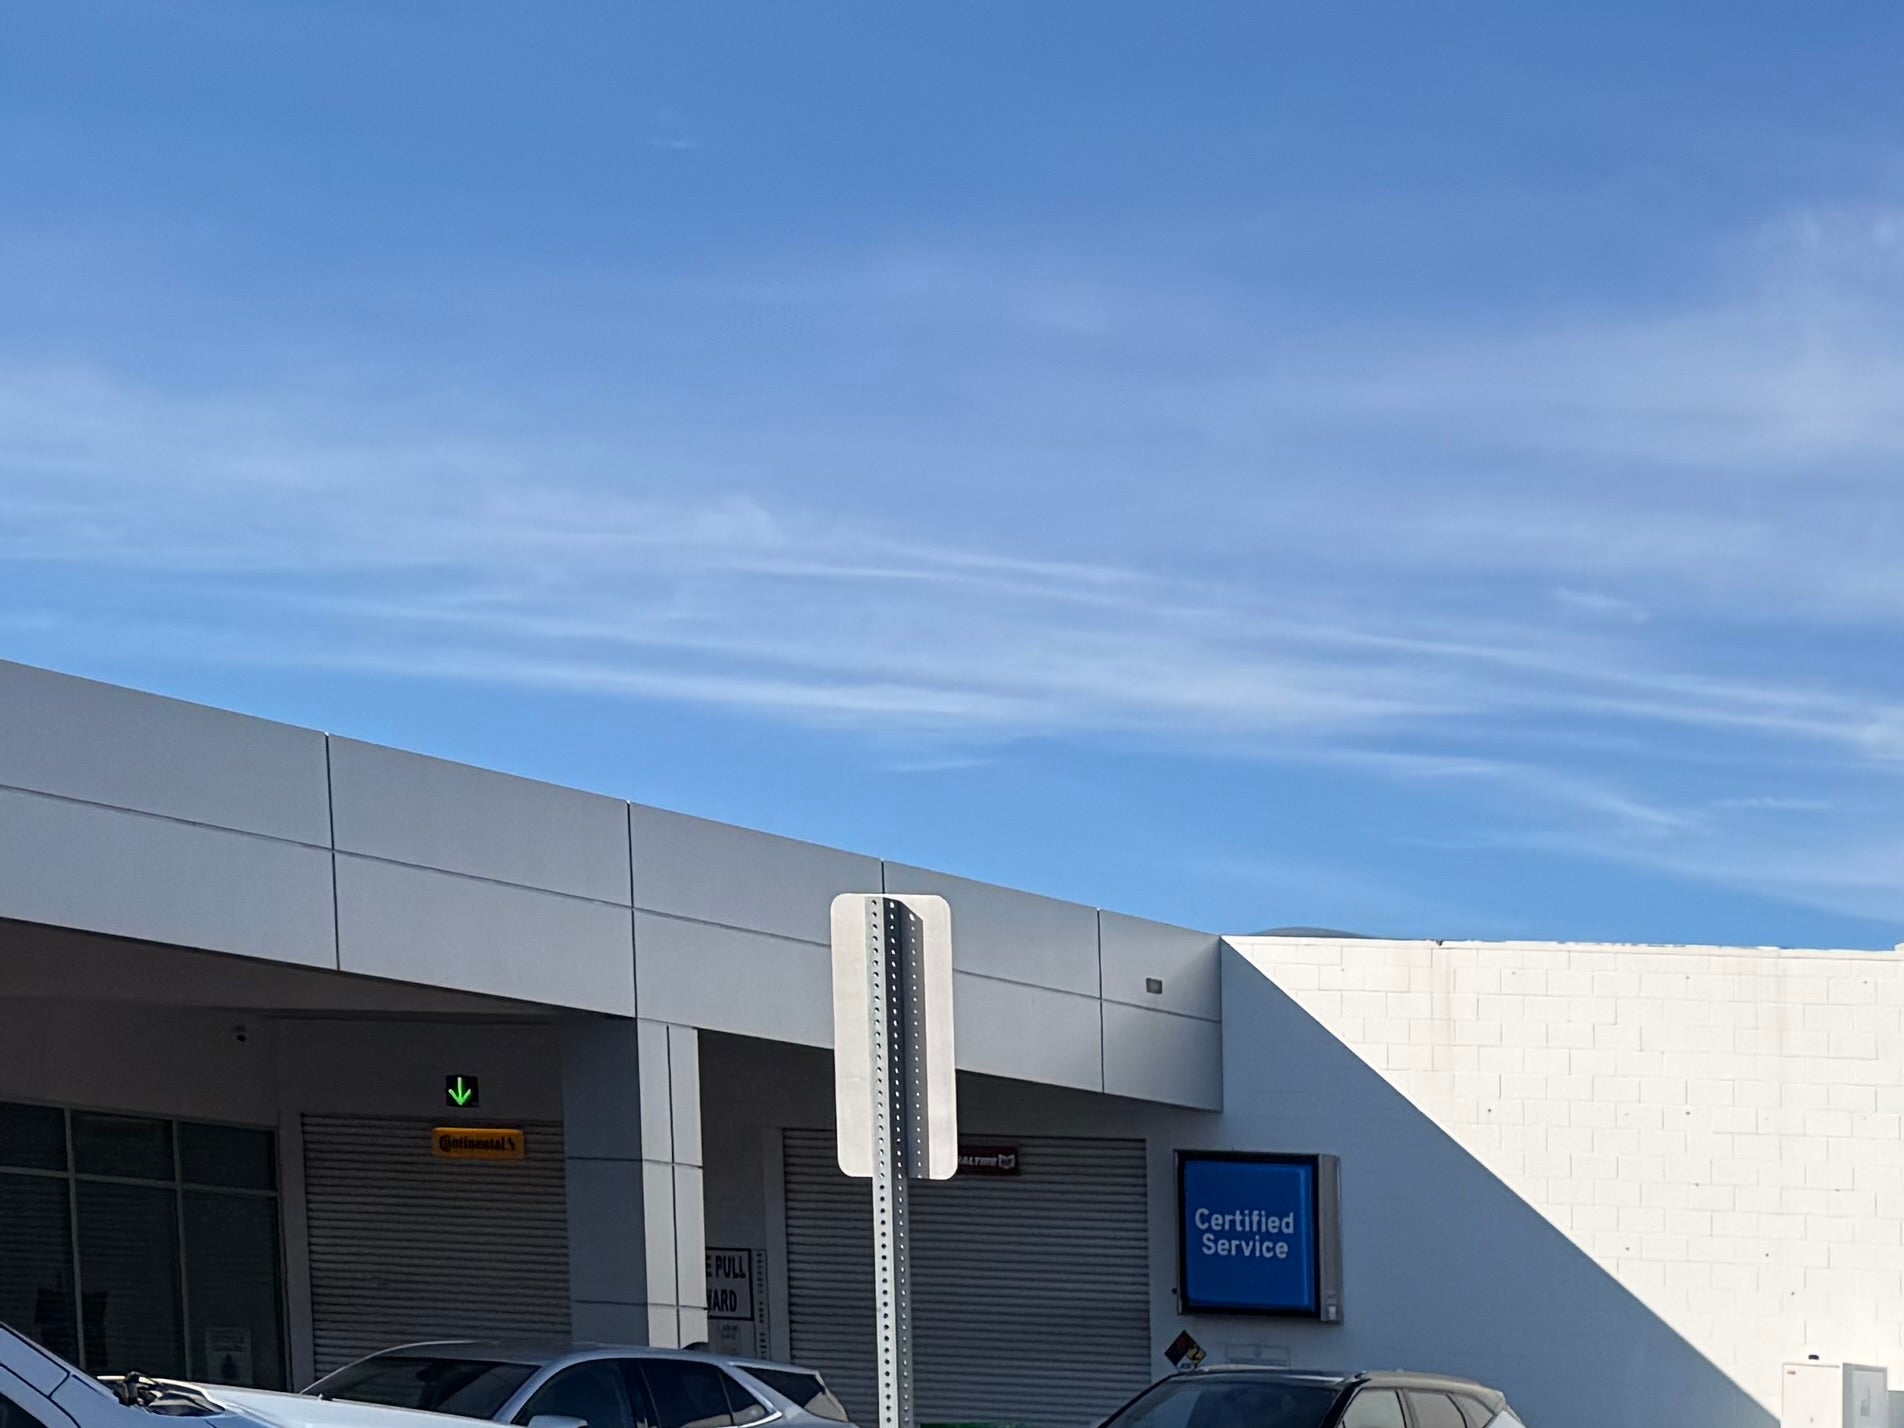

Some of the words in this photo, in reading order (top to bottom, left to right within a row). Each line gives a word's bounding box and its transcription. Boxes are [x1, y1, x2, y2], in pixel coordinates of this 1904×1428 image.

[440, 1134, 505, 1152] Continental
[1195, 1208, 1294, 1234] Certified
[1202, 1233, 1289, 1259] Service
[716, 1255, 746, 1279] PULL
